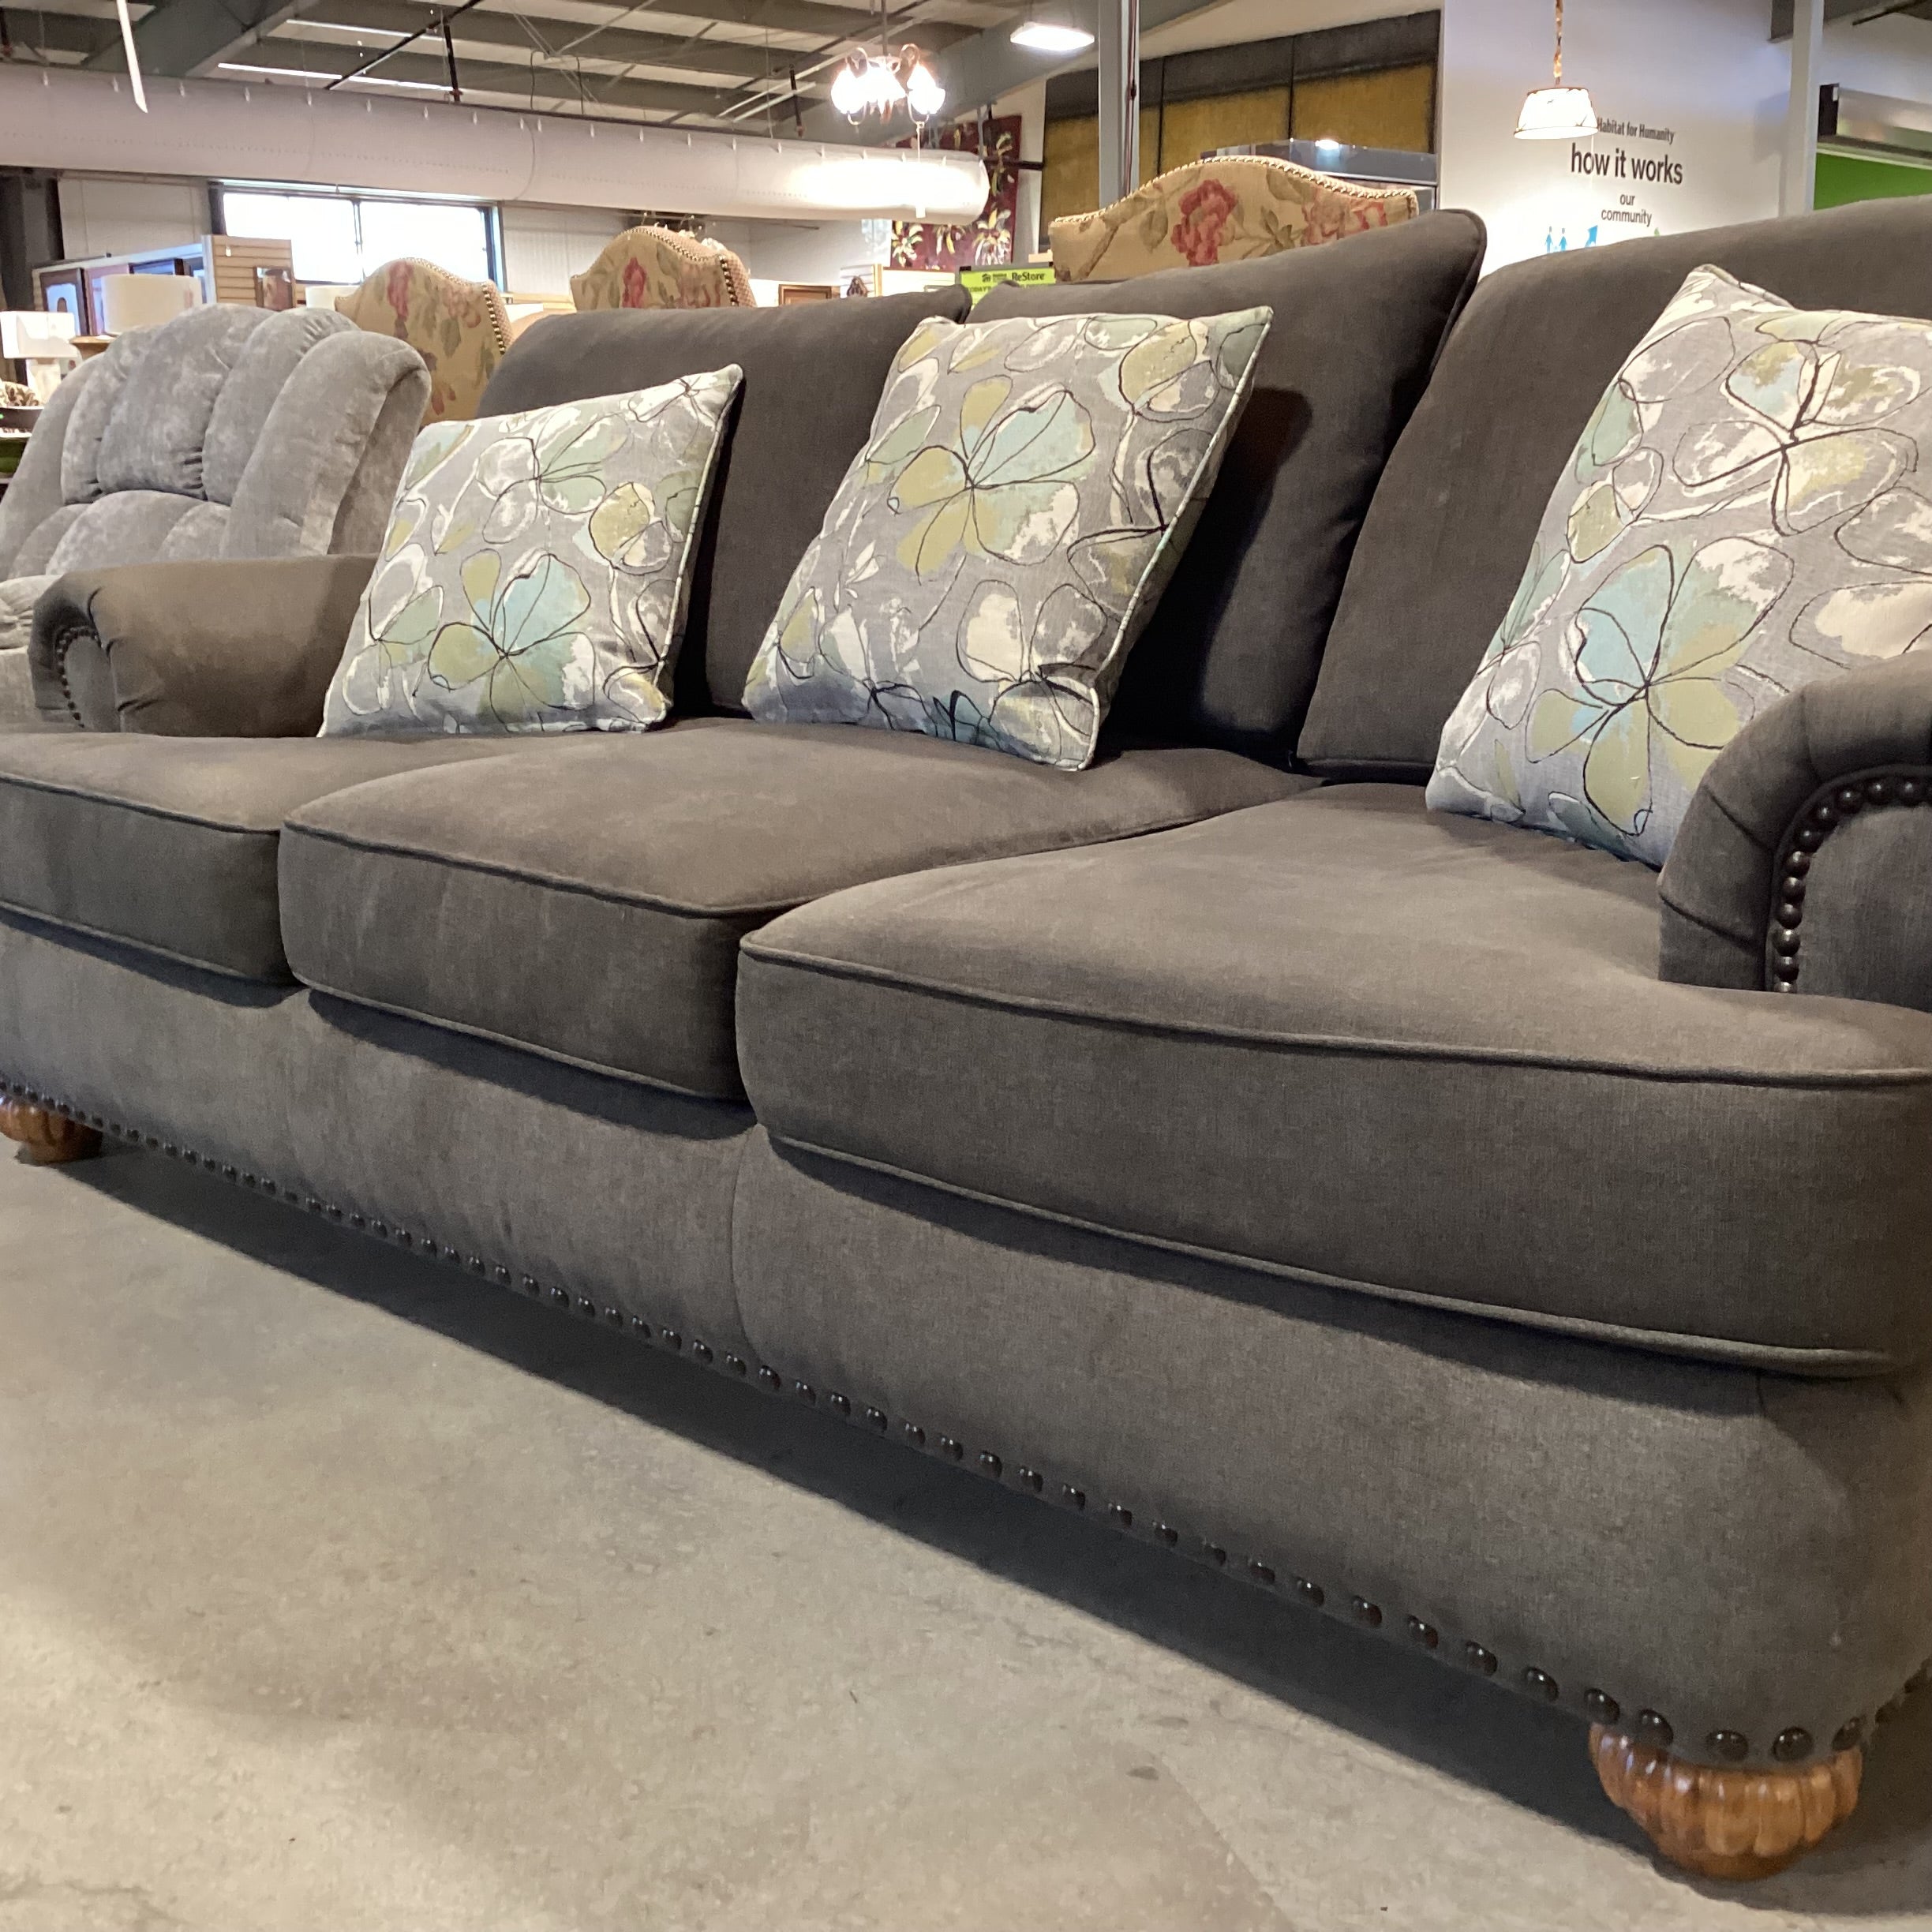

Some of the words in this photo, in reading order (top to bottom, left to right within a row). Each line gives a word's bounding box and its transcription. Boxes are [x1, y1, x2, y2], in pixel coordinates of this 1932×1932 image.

[1597, 118, 1625, 136] Habitat
[1627, 122, 1638, 137] for
[1639, 124, 1675, 145] Humanity
[1571, 142, 1610, 175] how
[1615, 148, 1626, 178] it
[1631, 155, 1683, 185] works
[1619, 194, 1635, 206] our
[1601, 209, 1652, 227] community
[1011, 271, 1045, 281] ReStore
